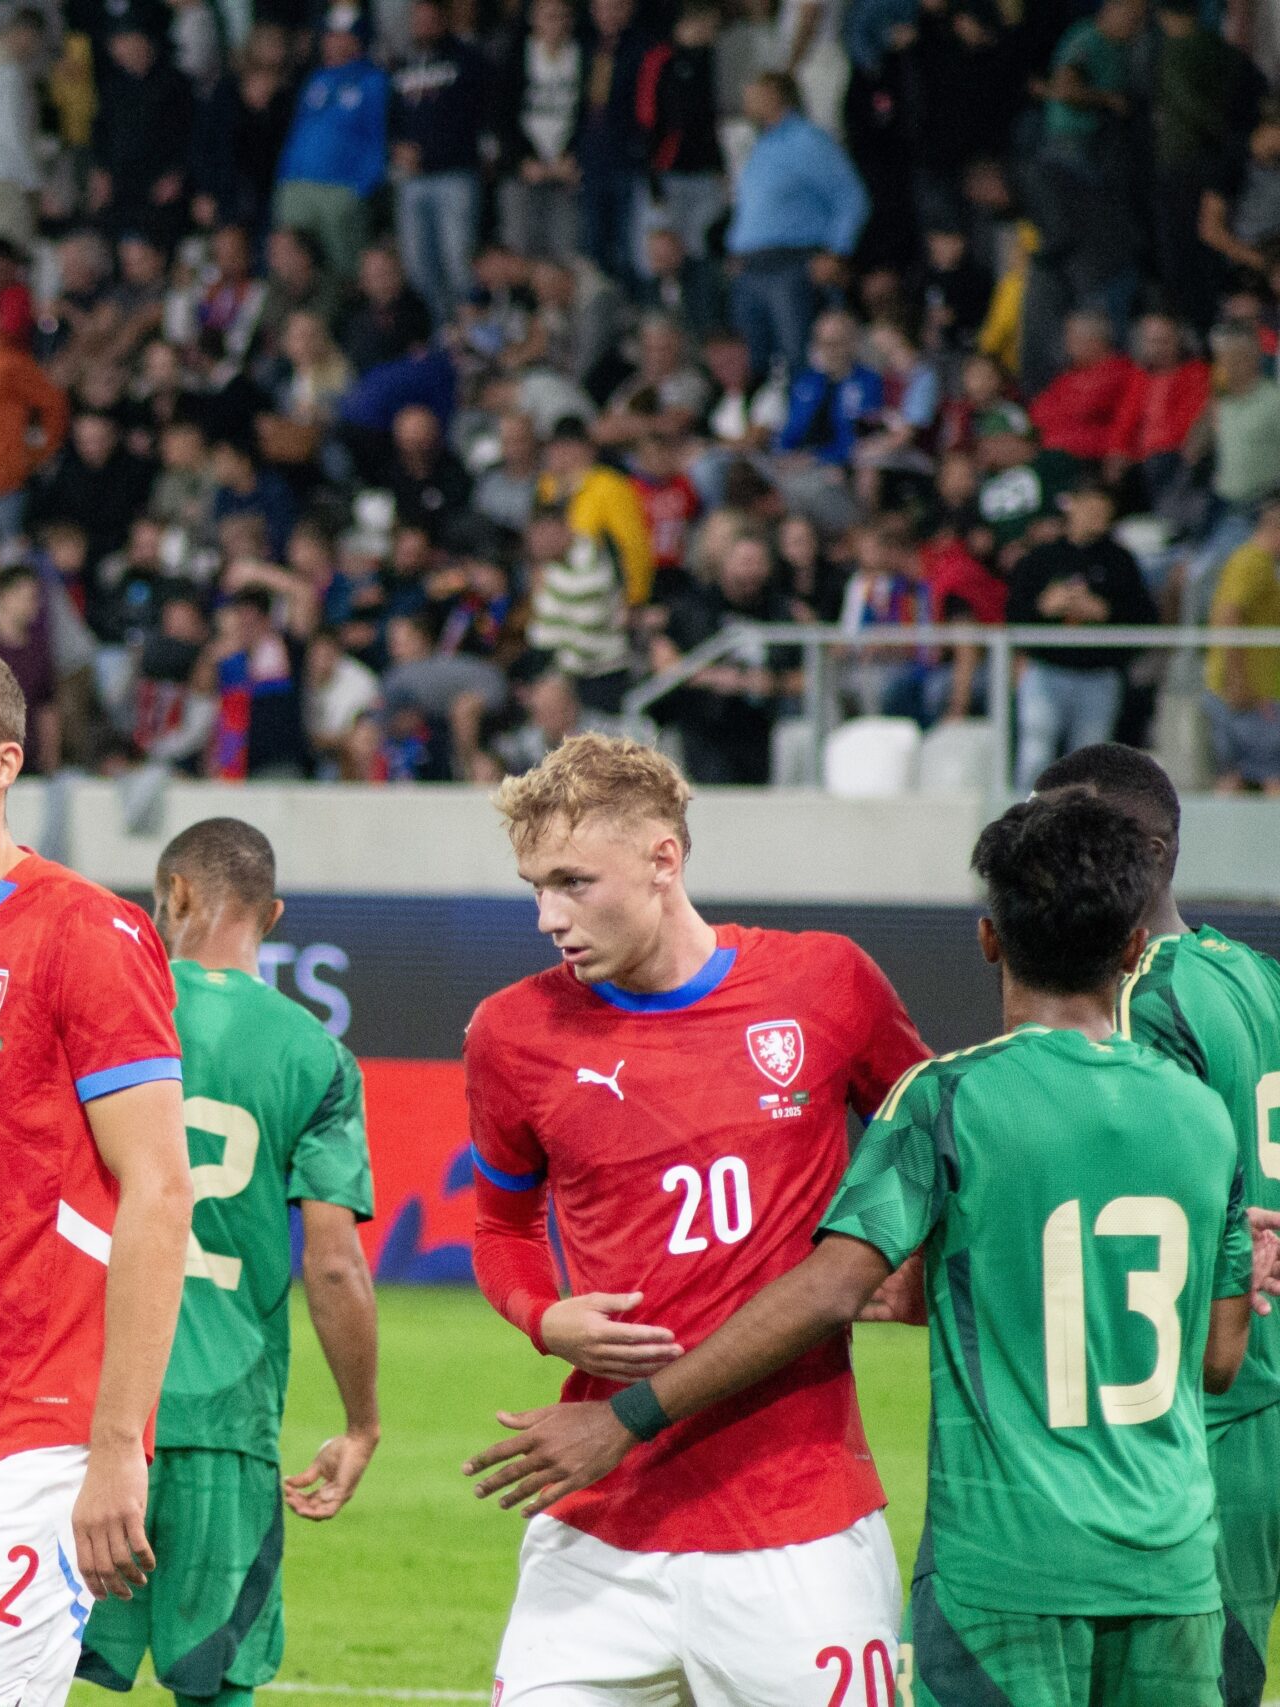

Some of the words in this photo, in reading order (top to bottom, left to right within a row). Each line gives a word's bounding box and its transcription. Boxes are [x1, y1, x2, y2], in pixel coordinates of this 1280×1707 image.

[772, 1105, 802, 1119] 8.9.2025
[662, 1155, 753, 1255] 20
[1042, 1196, 1190, 1429] 13
[815, 1639, 897, 1707] 20
